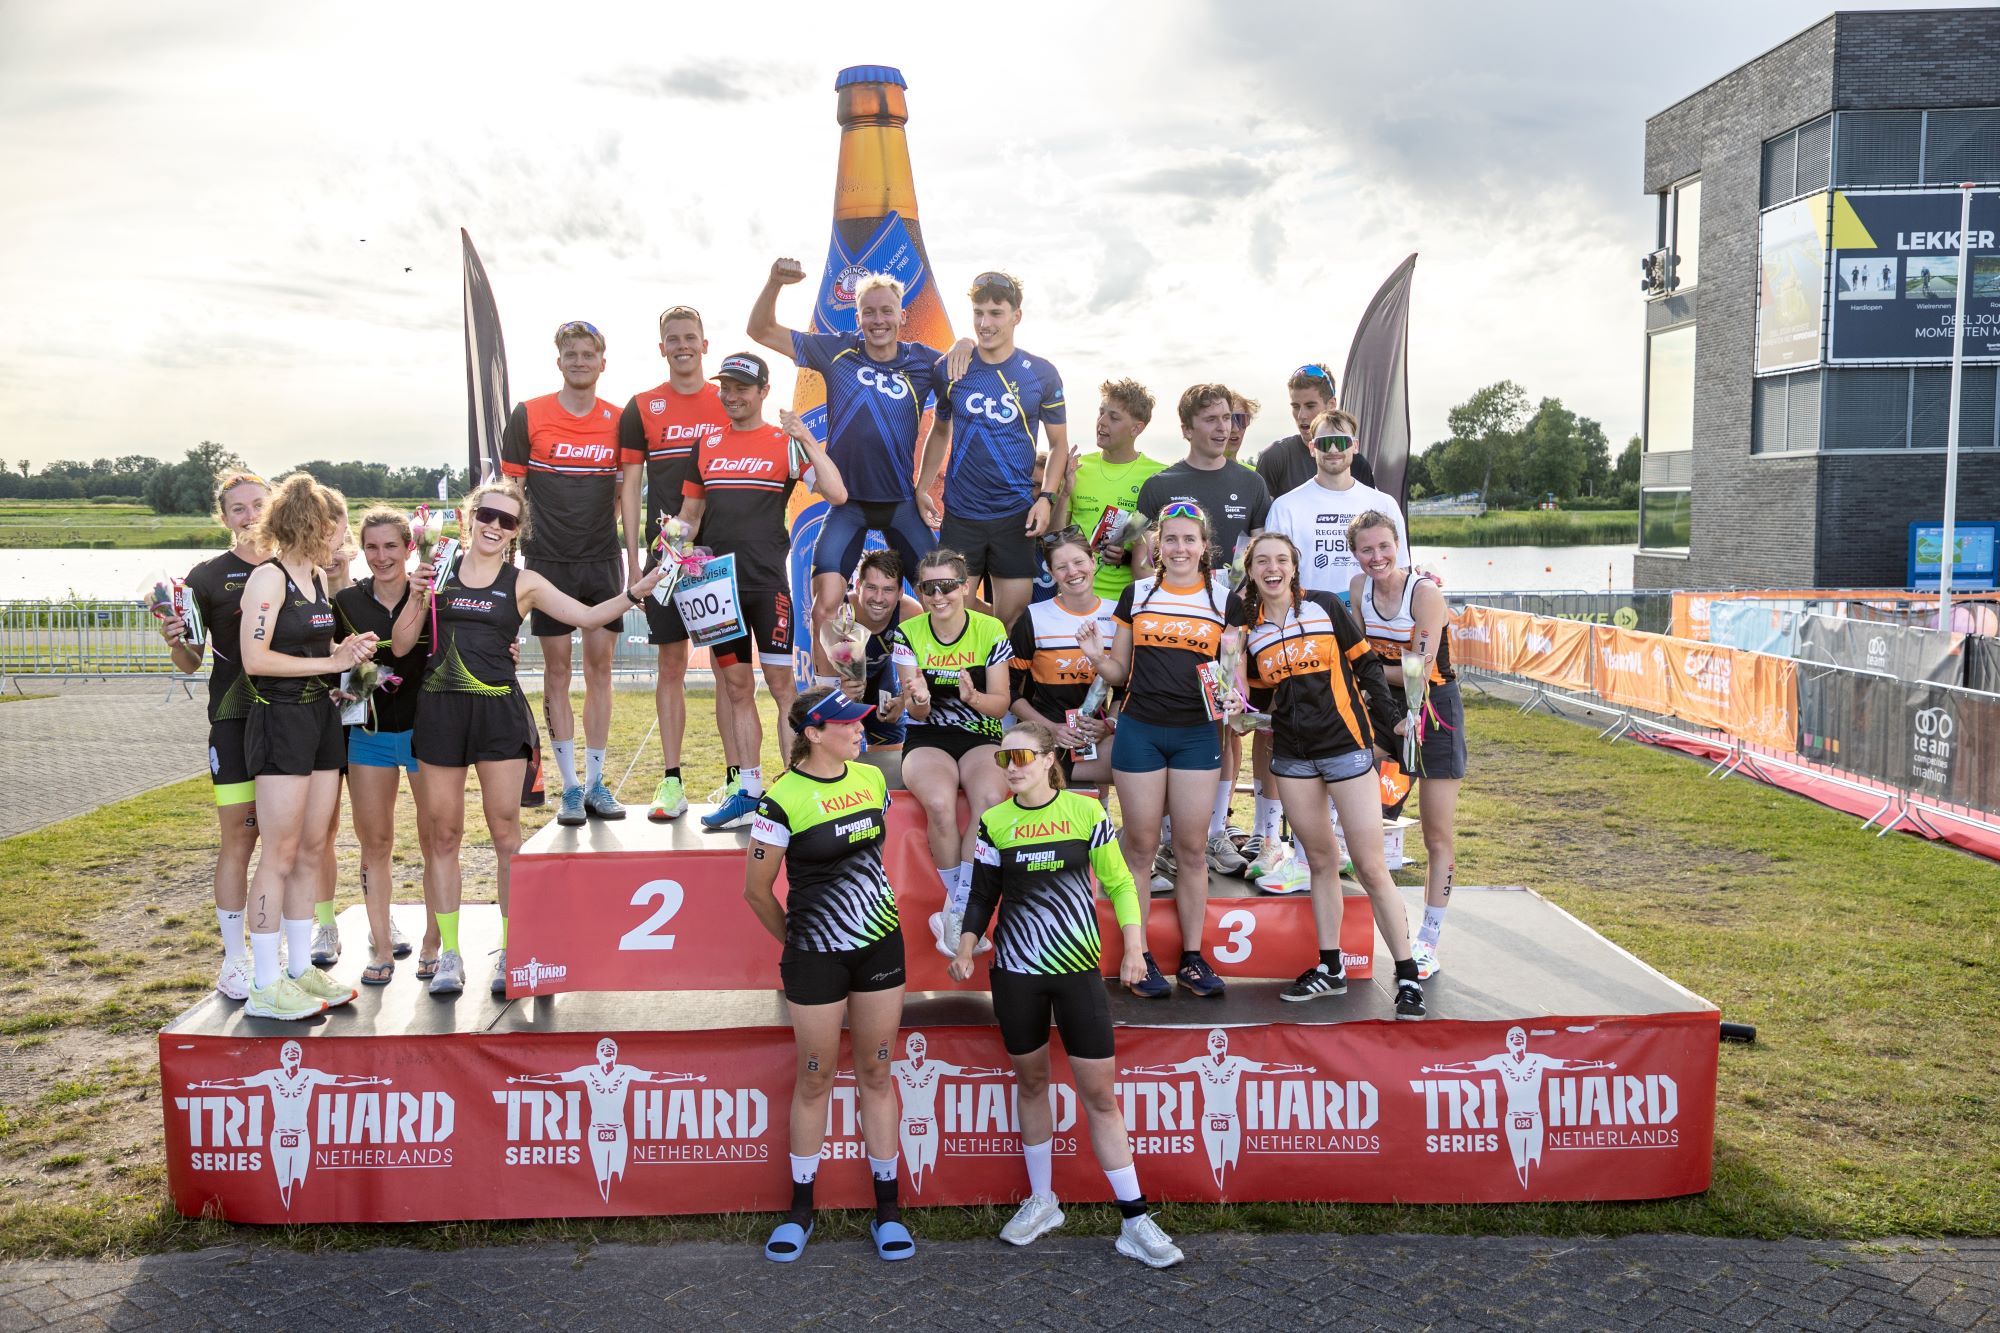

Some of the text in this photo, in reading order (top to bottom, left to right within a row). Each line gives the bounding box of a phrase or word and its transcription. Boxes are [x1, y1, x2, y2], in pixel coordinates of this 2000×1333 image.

[1897, 231, 1994, 250] LEKKER
[896, 256, 909, 271] FREI
[1915, 327, 1989, 338] MOMETEN
[1142, 634, 1208, 649] TVS '90
[927, 651, 975, 667] KIJANI
[1867, 654, 1885, 667] team
[1057, 672, 1088, 680] TVS
[1268, 660, 1320, 680] TVS '90
[1914, 733, 1950, 758] team
[1912, 765, 1947, 784] triathlon
[821, 789, 874, 814] KIJANI
[848, 825, 881, 844] design
[1014, 821, 1070, 840] KIJANI
[753, 848, 766, 860] 8
[1027, 859, 1065, 872] design
[618, 879, 685, 951] 2
[1213, 909, 1256, 964] 3
[1344, 955, 1369, 966] HARD
[510, 965, 567, 981] TRI HARD
[1113, 1080, 1379, 1131] TRI HARD
[1410, 1074, 1678, 1129] TRI HARD
[174, 1091, 455, 1147] TRI HARD
[492, 1090, 581, 1141] TRI
[633, 1088, 769, 1140] HARD
[1516, 1119, 1530, 1128] 036
[911, 1125, 925, 1134] 036
[1213, 1121, 1227, 1130] 036
[282, 1136, 297, 1147] 036
[600, 1131, 614, 1141] 036
[1128, 1135, 1380, 1155] SERIES NETHERLANDS
[1426, 1130, 1678, 1153] SERIES NETHERLANDS
[505, 1144, 769, 1165] SERIES NETHERLANDS
[820, 1138, 1077, 1160] SERI NETHERLDS
[191, 1148, 454, 1171] SERIES NETHERLANDS
